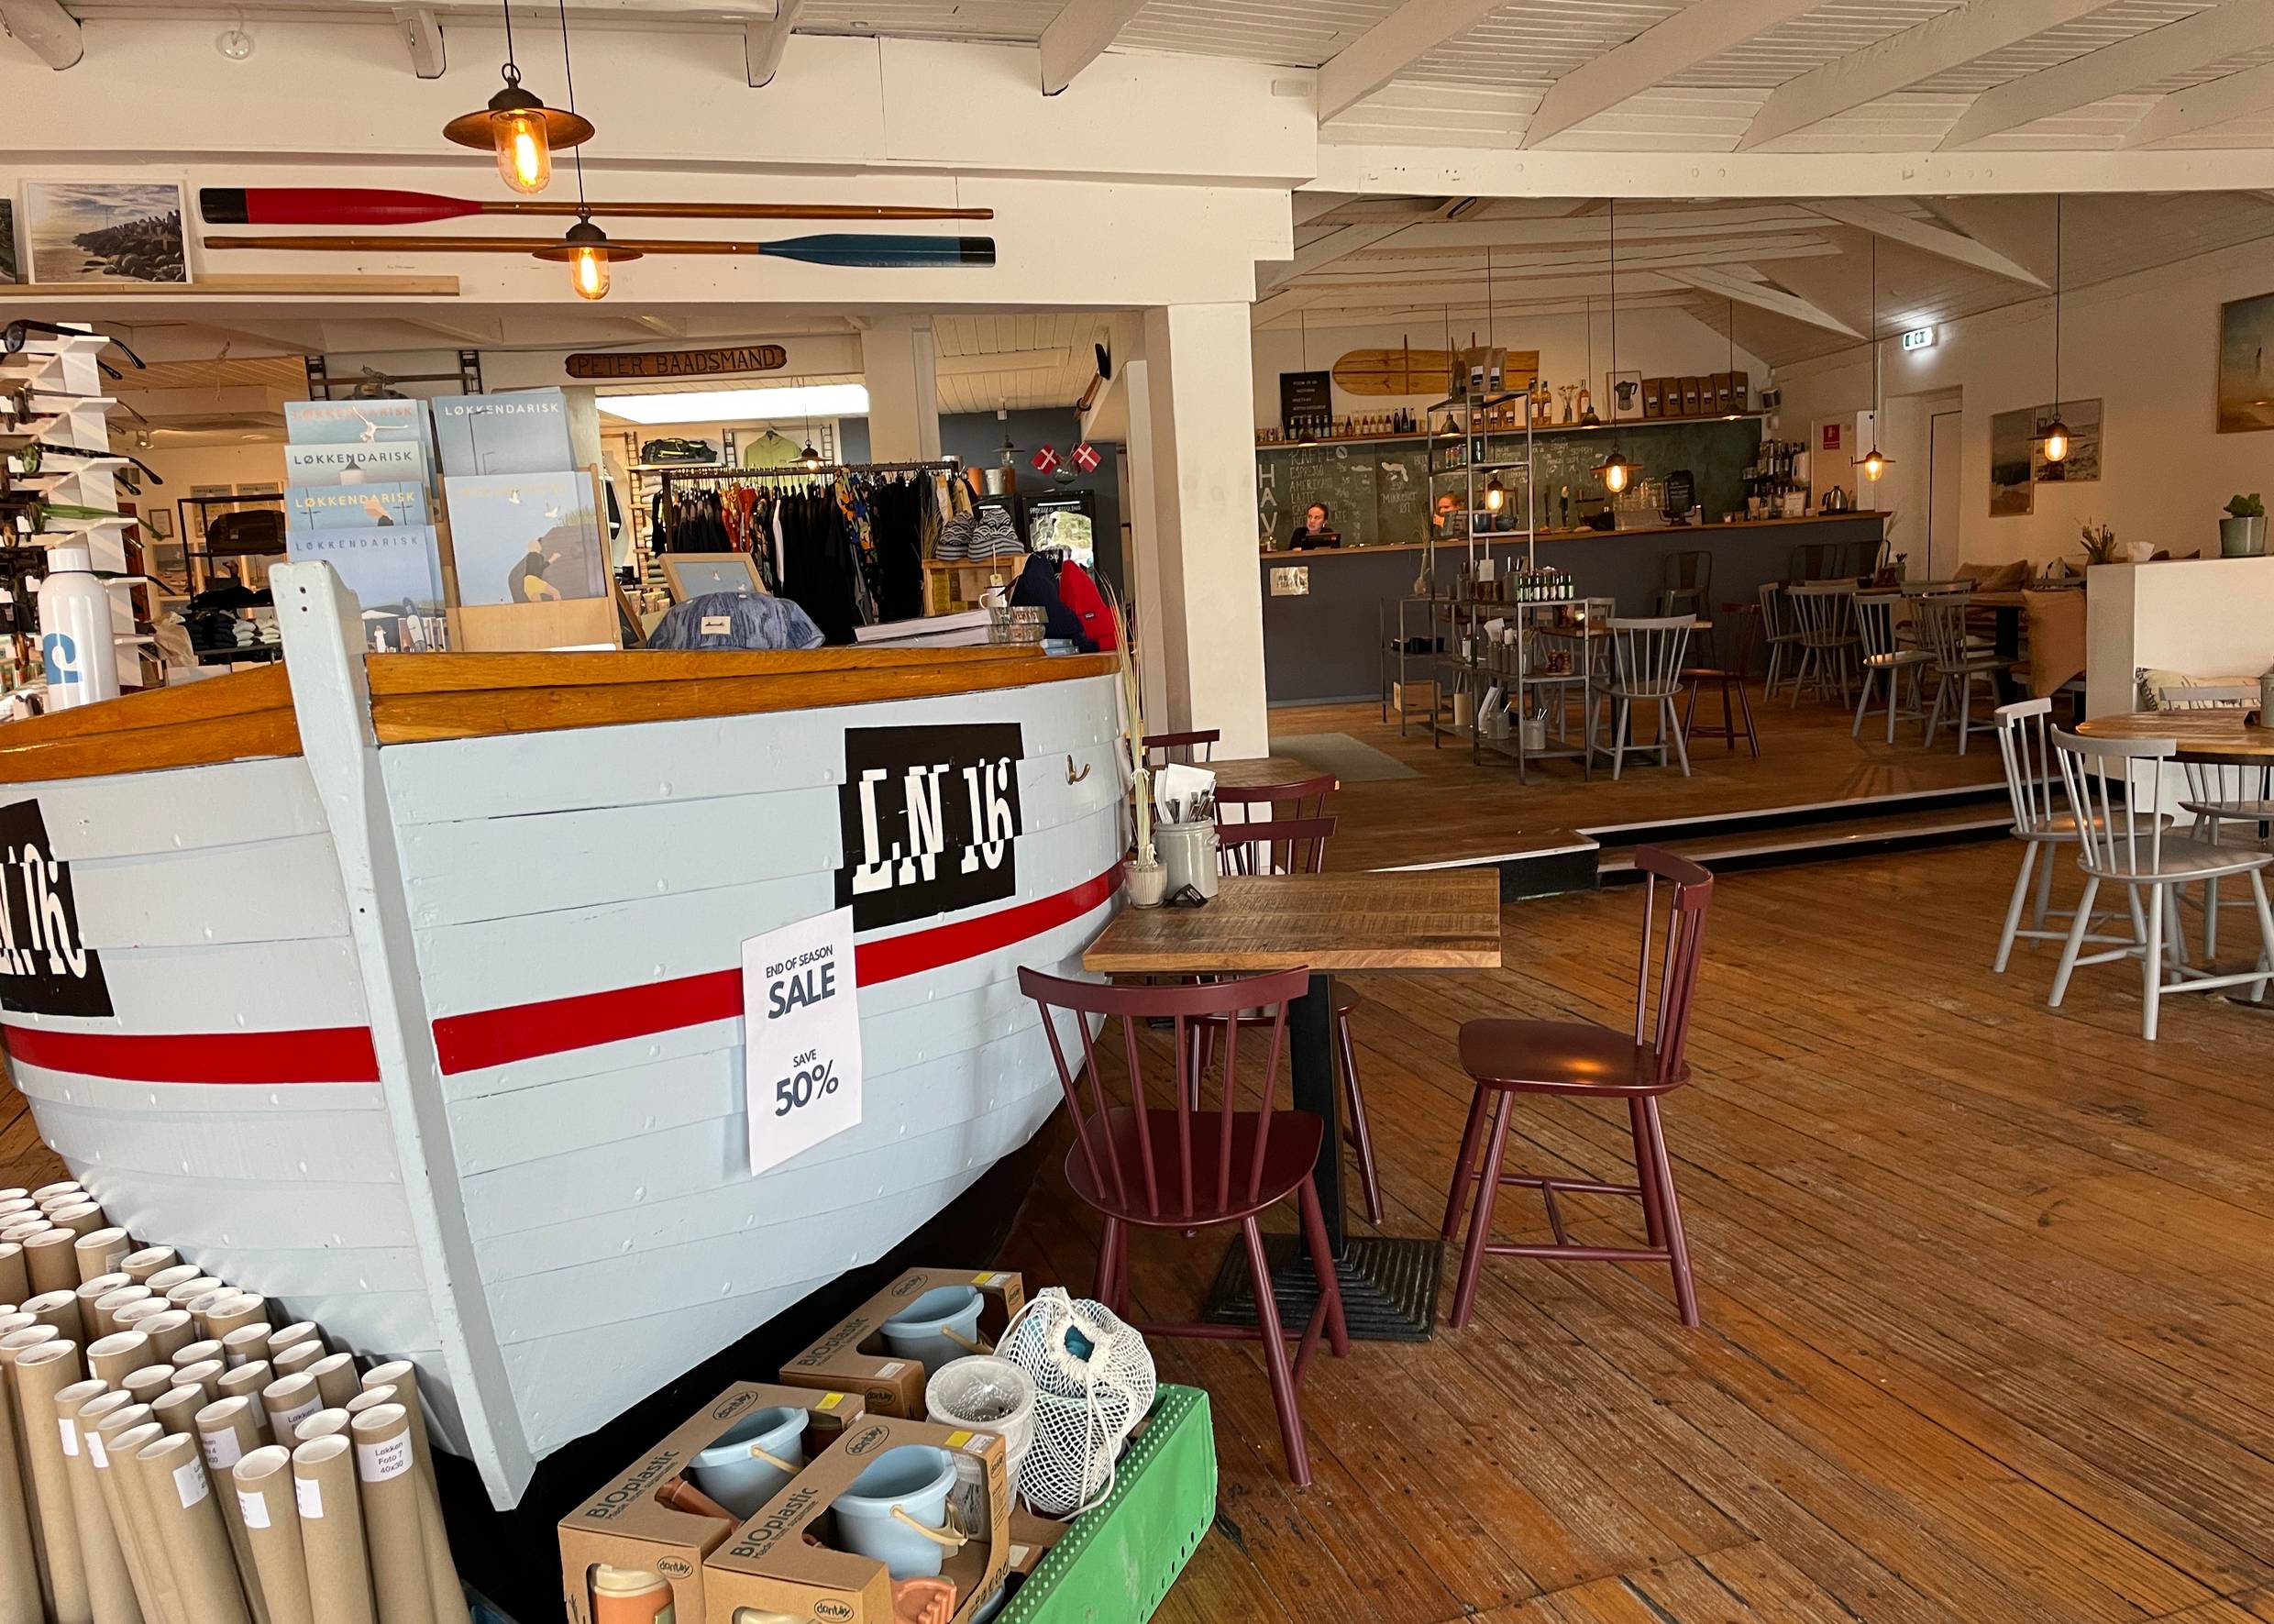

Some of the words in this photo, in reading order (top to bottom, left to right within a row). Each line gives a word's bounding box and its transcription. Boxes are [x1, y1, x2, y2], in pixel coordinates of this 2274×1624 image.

[577, 356, 642, 375] PETER
[656, 348, 778, 373] BAADSMAND
[445, 403, 559, 416] LØKKENDARISK
[294, 451, 413, 465] LØKKENDARISK
[295, 492, 415, 508] LØKKENDARISK
[296, 536, 418, 552] LØKKENDARISK
[853, 764, 949, 895] LN
[961, 757, 1014, 874] 16
[766, 963, 784, 978] END
[785, 957, 798, 971] OF
[799, 944, 833, 967] SEASON
[767, 961, 835, 1020] SALE
[793, 1048, 817, 1067] SAVE
[775, 1059, 839, 1117] 50%
[378, 1455, 395, 1465] Foto
[380, 1459, 404, 1474] 40x30
[586, 1450, 680, 1519] BIOplastic
[730, 1486, 819, 1558] BIOplastic
